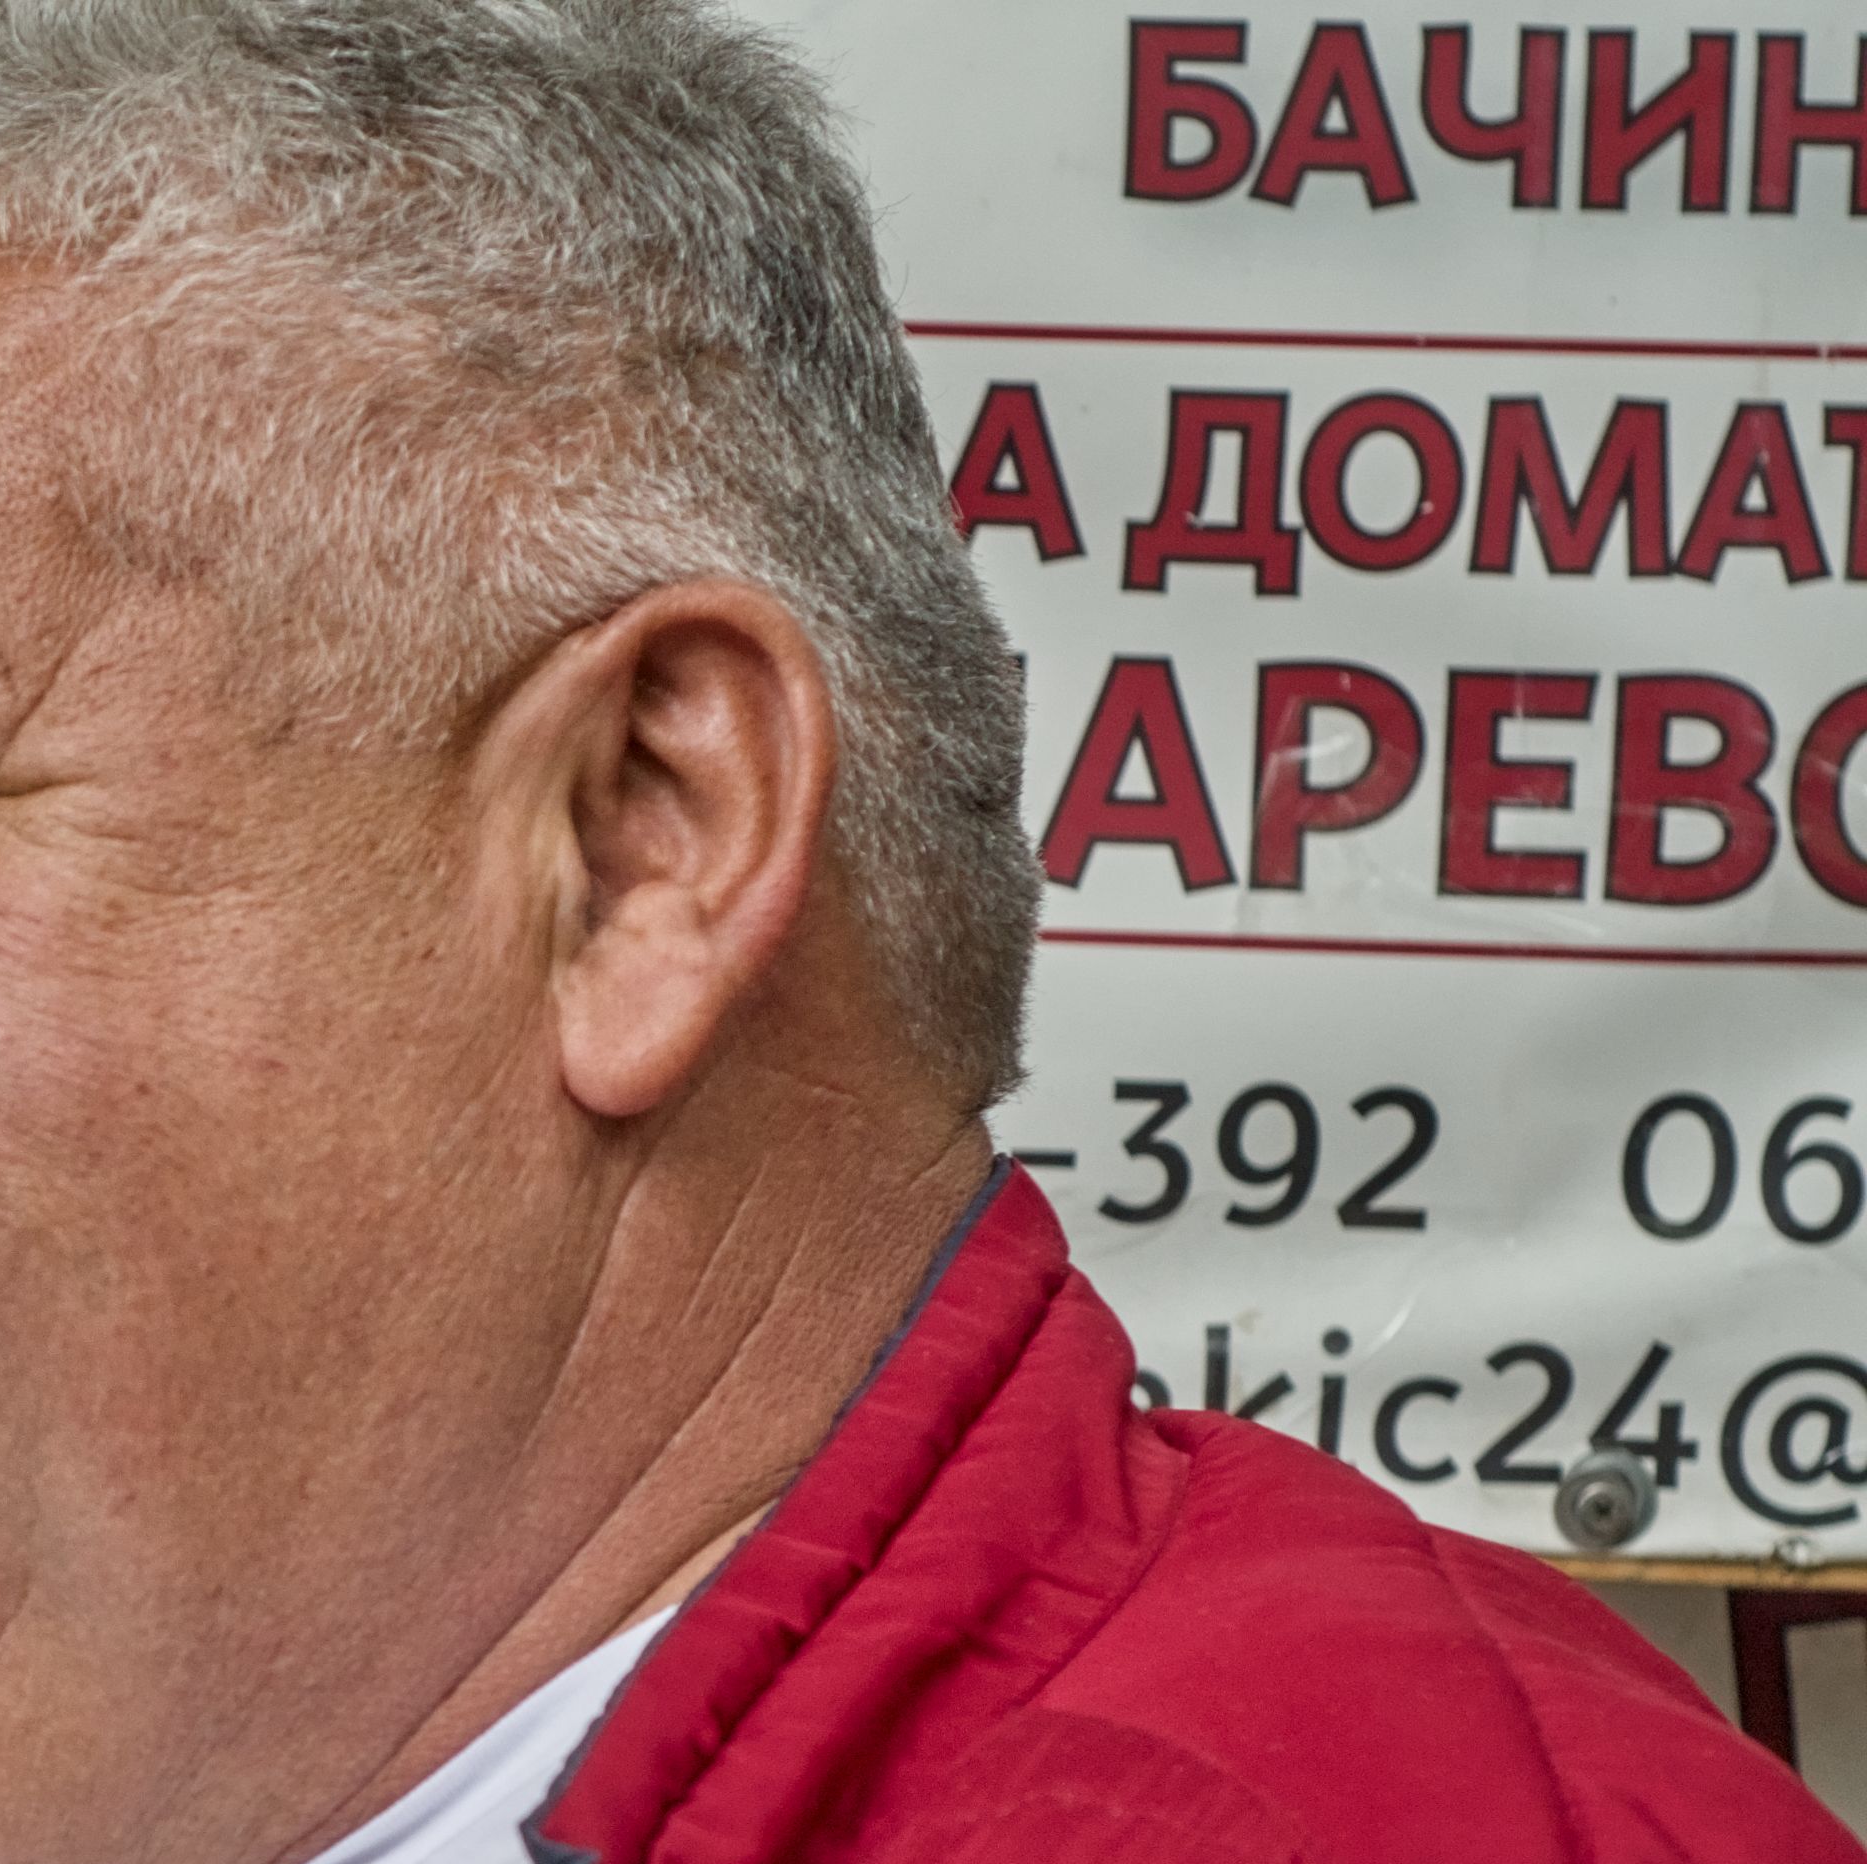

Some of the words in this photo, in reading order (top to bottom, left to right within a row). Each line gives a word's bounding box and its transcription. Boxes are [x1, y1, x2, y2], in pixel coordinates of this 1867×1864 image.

[1017, 652, 1867, 914] АРЕВ
[1620, 1091, 1867, 1248] 06
[1133, 1320, 1867, 1530] kic24@
